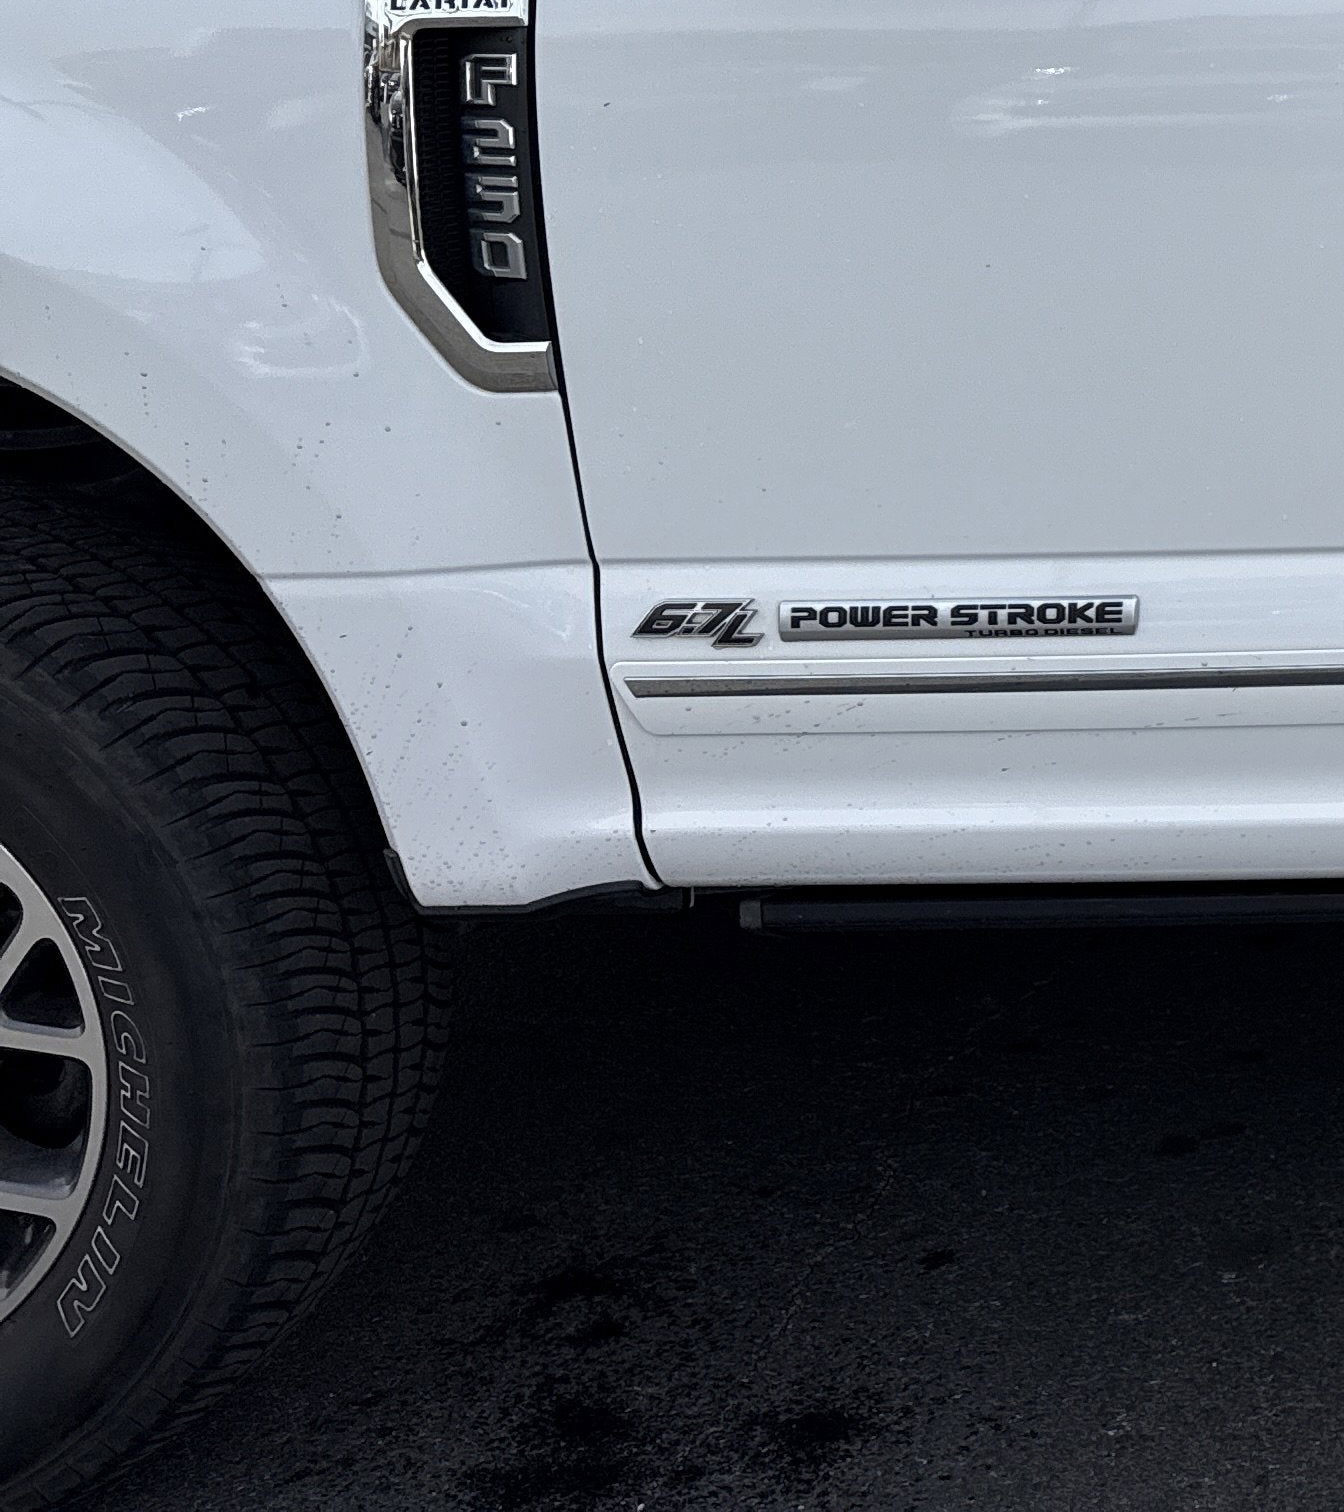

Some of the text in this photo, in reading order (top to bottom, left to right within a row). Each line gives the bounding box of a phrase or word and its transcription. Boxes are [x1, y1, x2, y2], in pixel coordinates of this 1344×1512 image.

[632, 597, 1125, 650] 6.7L POWER STROKE
[964, 626, 1122, 638] TURBO DIESEL
[56, 895, 152, 1339] MICHELIN
